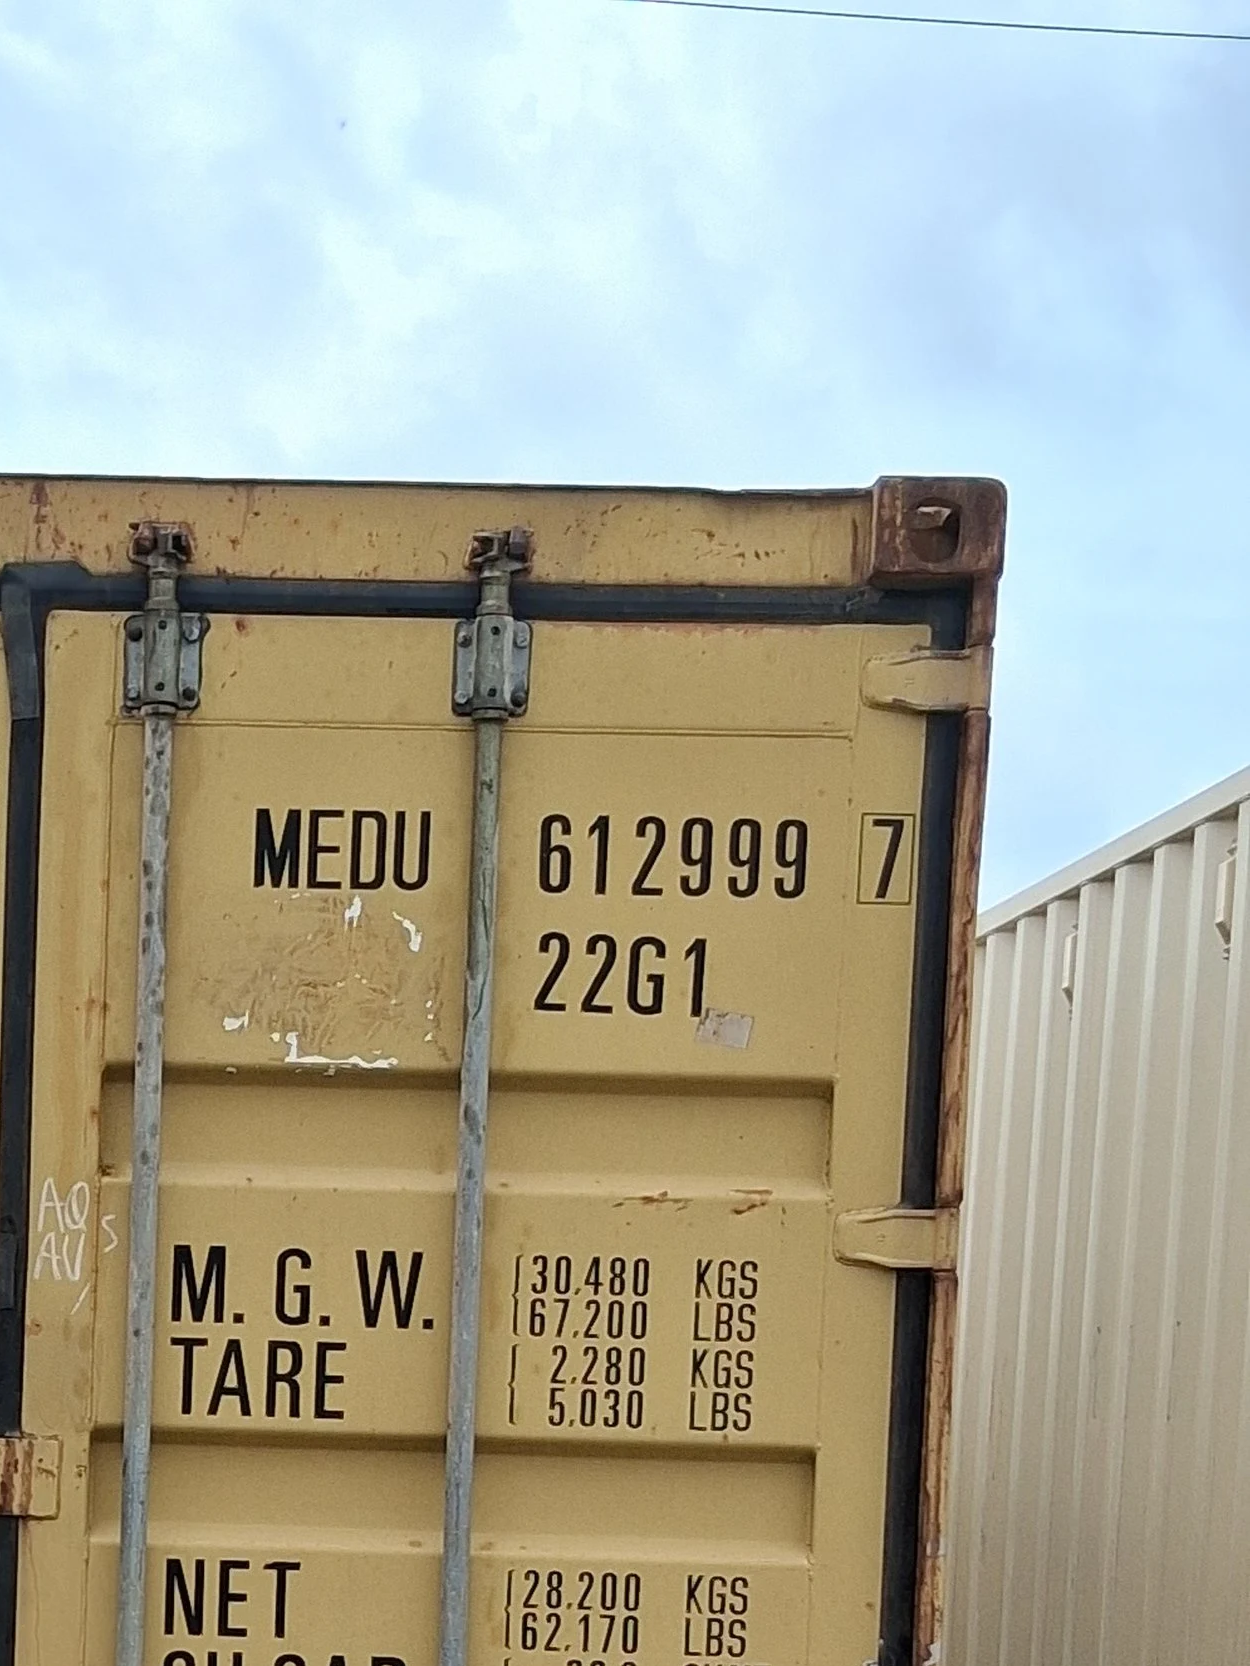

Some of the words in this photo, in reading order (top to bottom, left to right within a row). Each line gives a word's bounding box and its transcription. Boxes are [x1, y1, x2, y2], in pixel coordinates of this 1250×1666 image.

[252, 807, 433, 892] MEDU
[538, 812, 810, 900] 612999
[871, 817, 906, 900] 7
[533, 930, 708, 1018] 22G1
[694, 1257, 759, 1301] KGS
[692, 1300, 757, 1343] LBS
[169, 1335, 348, 1421] TARE
[690, 1347, 755, 1390] KGS
[688, 1390, 753, 1432] LBS
[163, 1556, 303, 1640] NET
[685, 1573, 750, 1616] KGS
[683, 1616, 748, 1659] LBS
